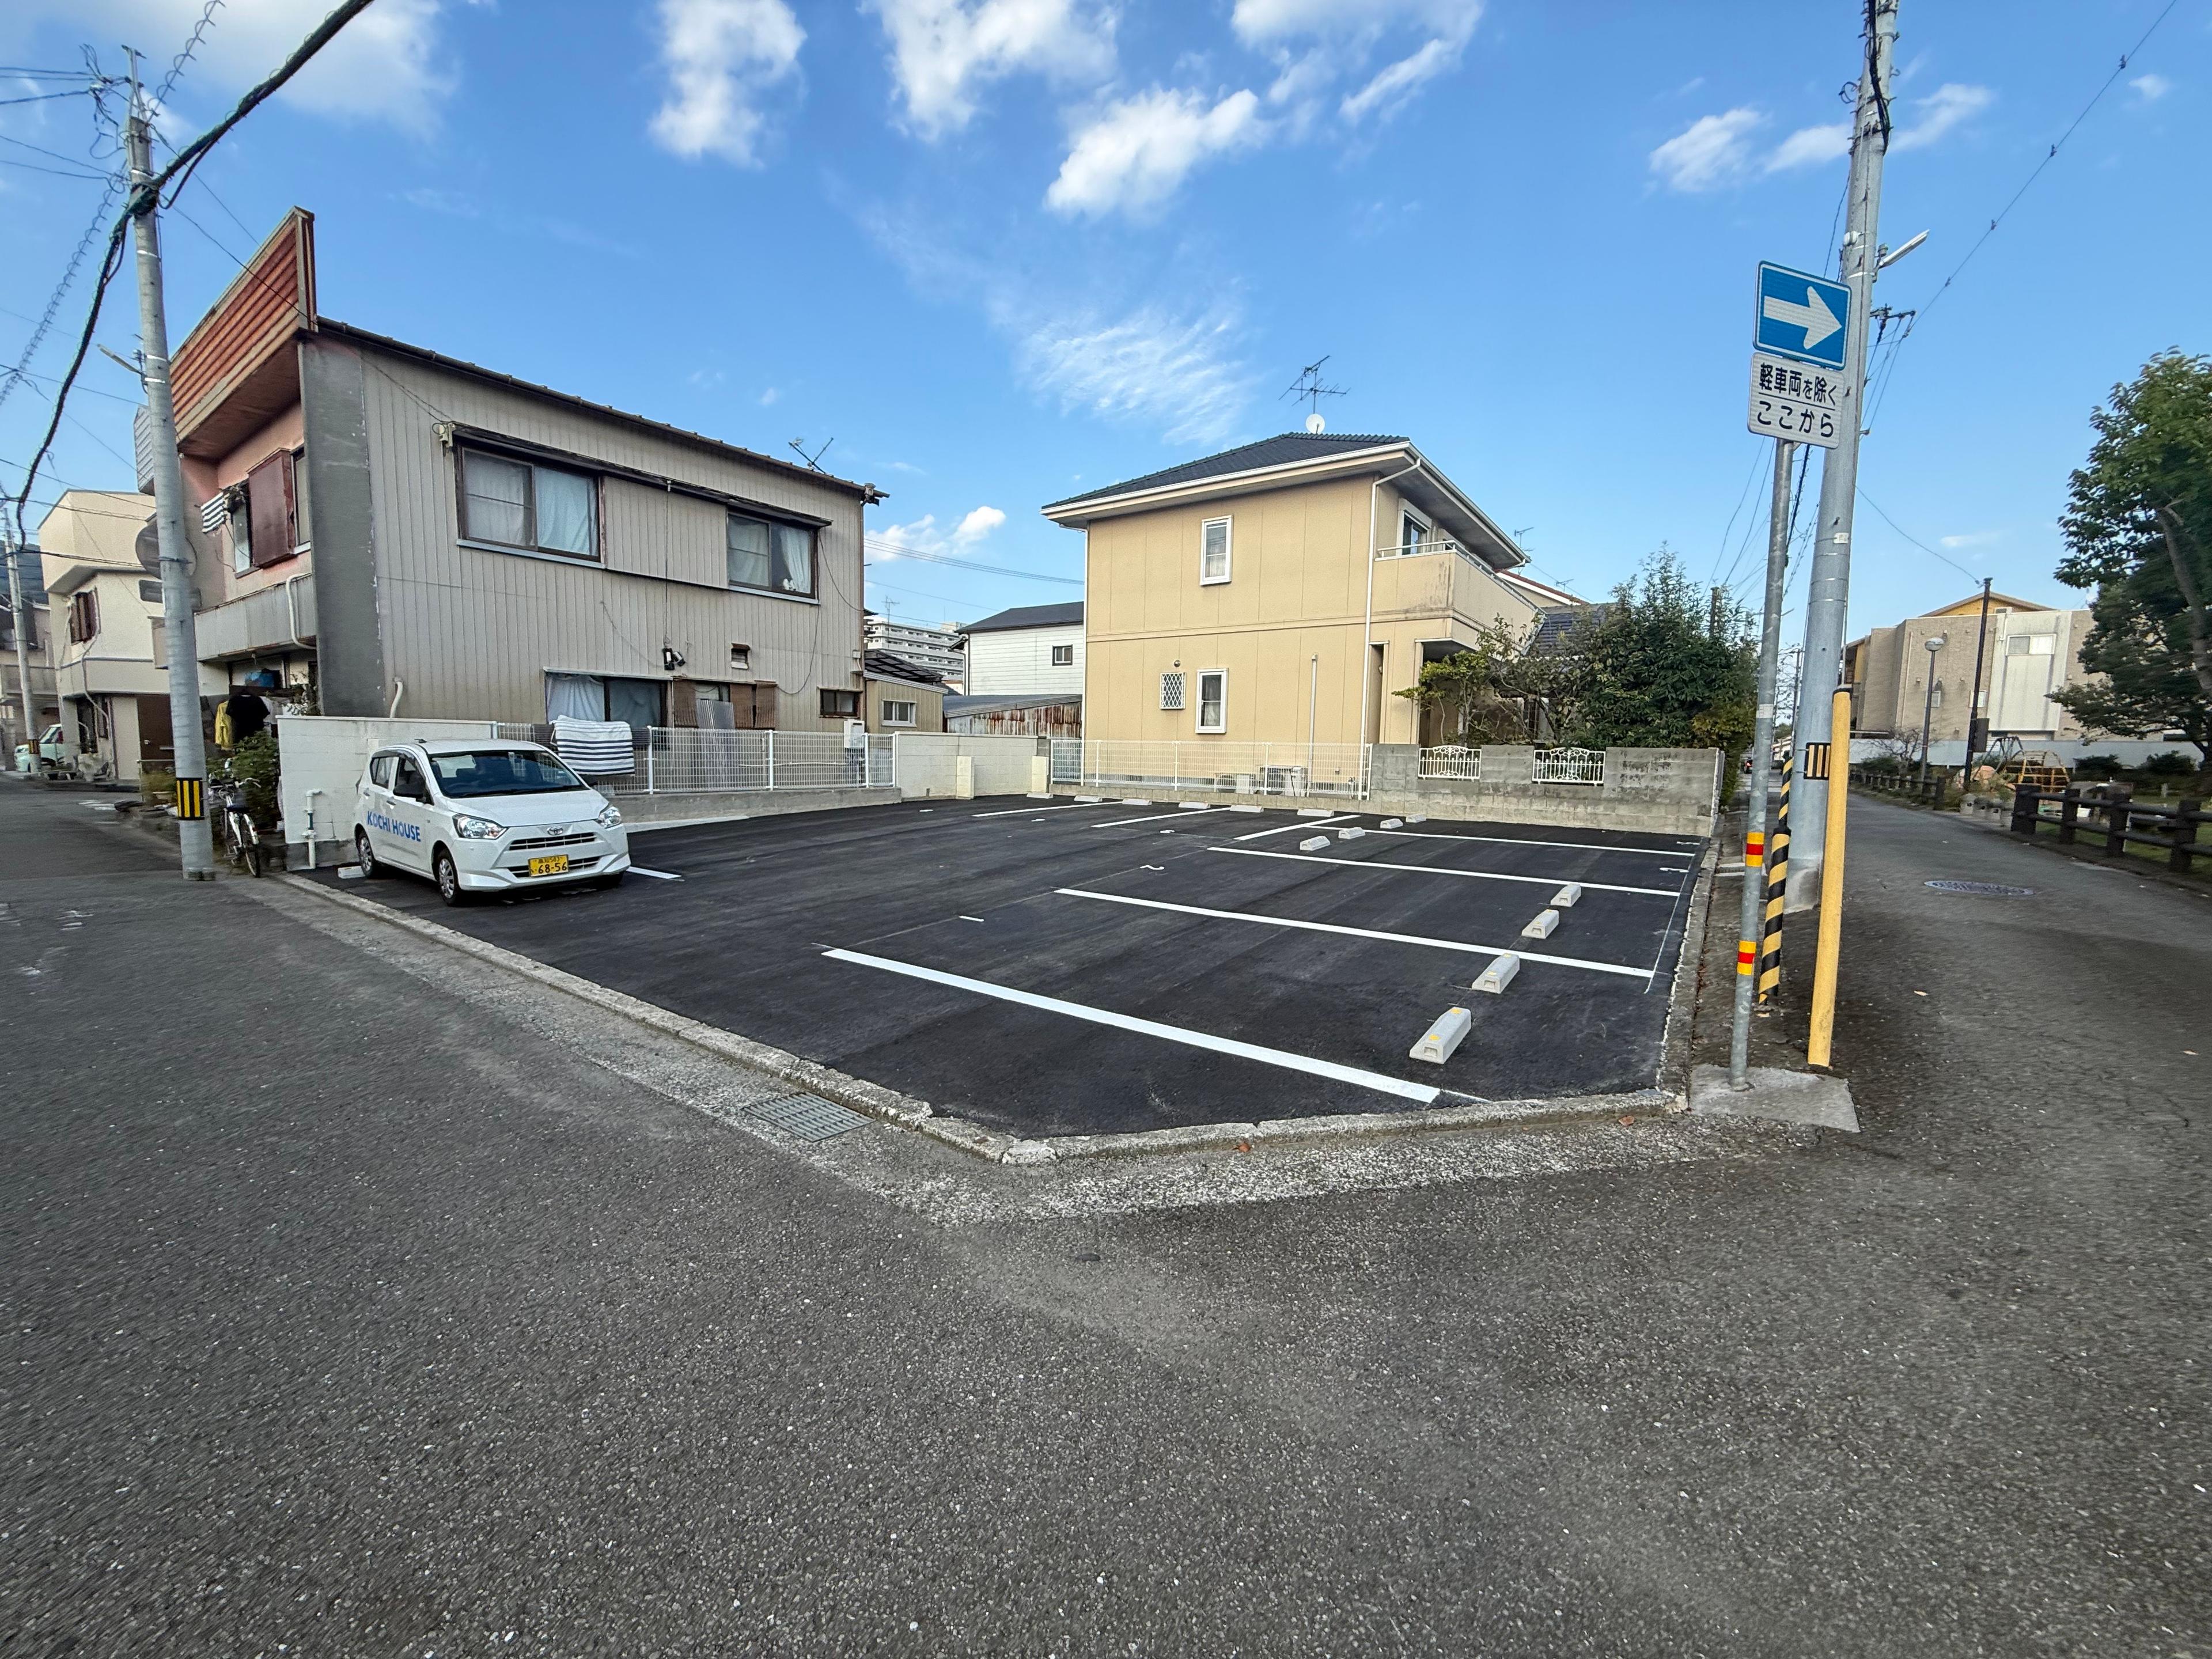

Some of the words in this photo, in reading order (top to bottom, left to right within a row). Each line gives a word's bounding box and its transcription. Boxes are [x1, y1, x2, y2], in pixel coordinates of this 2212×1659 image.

[1759, 362, 1838, 406] 軽車両を除く
[1757, 400, 1835, 438] ここから
[367, 810, 391, 832] KOCHI
[391, 818, 422, 842] HOUSE
[538, 862, 567, 874] 68-56
